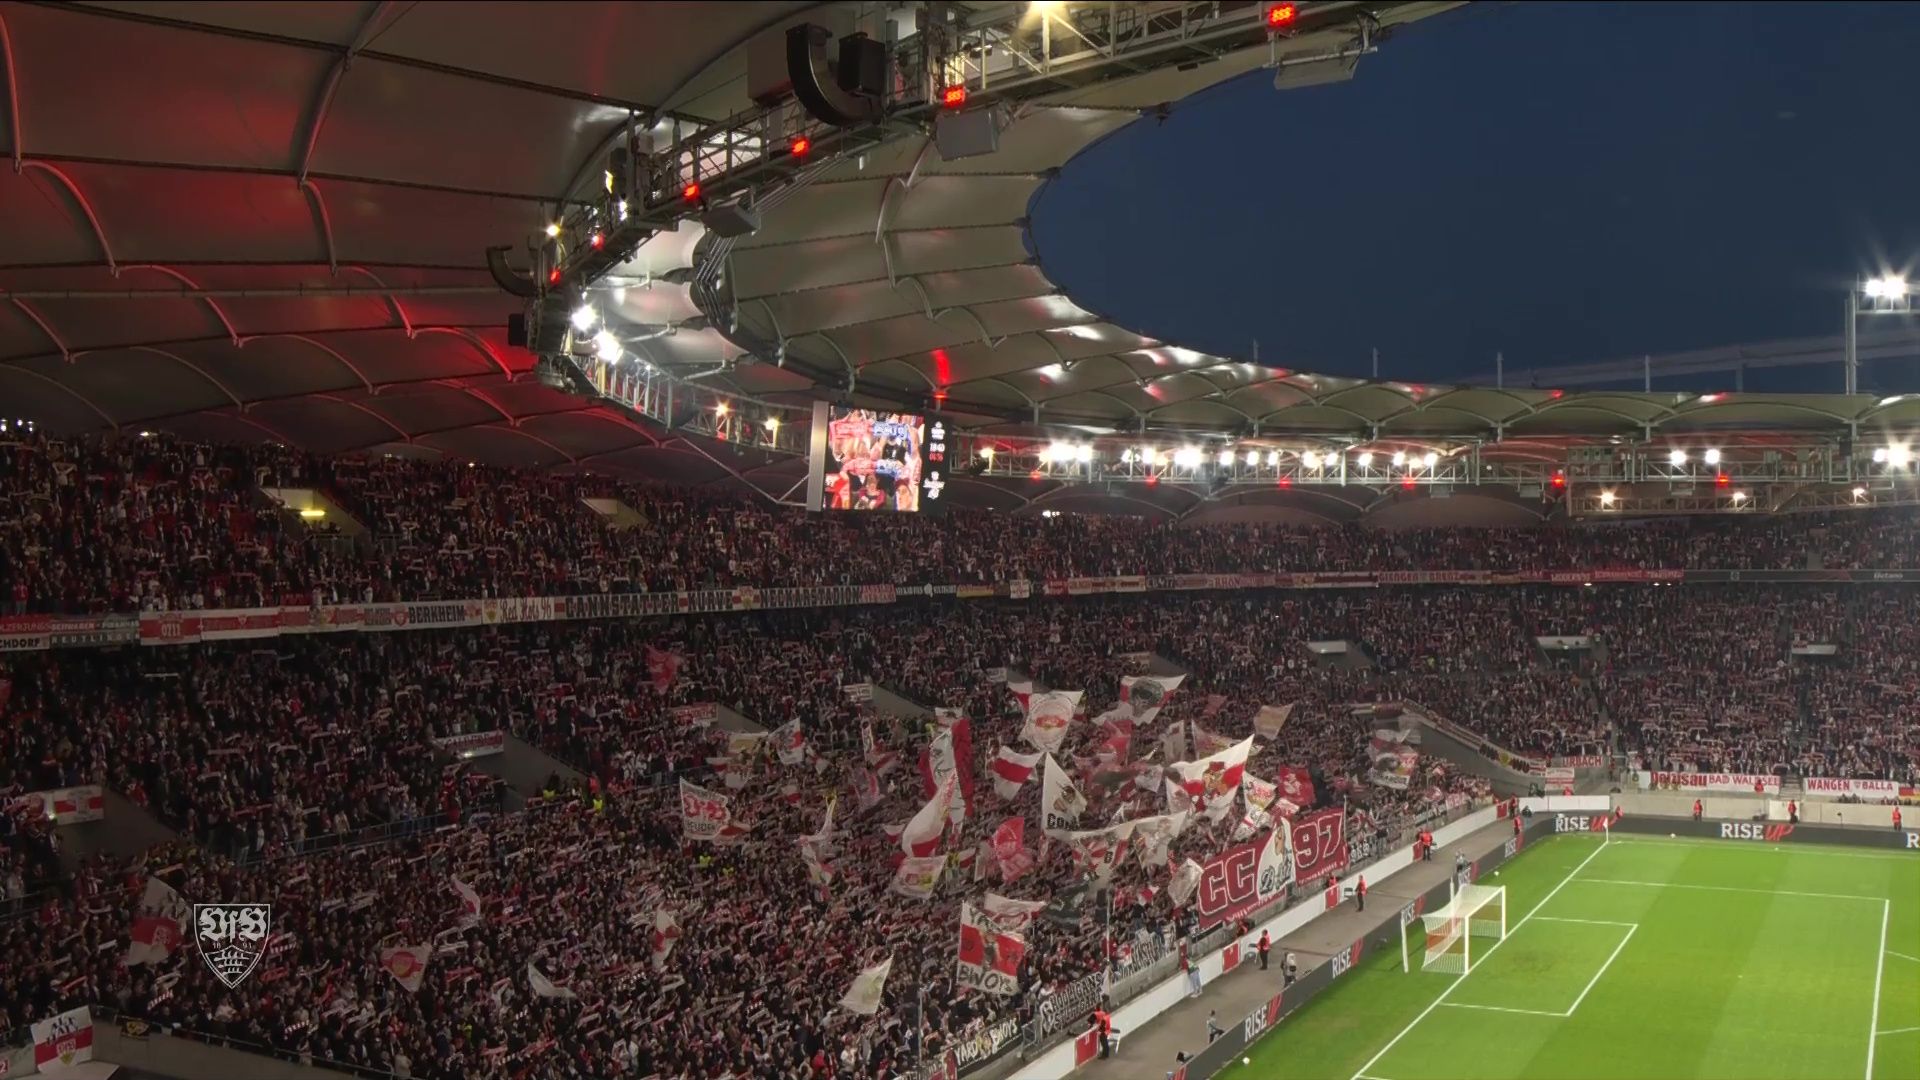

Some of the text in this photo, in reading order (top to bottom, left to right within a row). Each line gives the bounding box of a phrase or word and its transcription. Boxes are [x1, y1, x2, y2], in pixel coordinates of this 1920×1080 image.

[408, 605, 465, 624] BERKHEIM
[565, 593, 680, 618] CANNSTATTER
[687, 589, 733, 611] KURVE
[1708, 775, 1730, 785] BAD
[1808, 779, 1850, 791] WANGEN
[1555, 816, 1590, 833] RISE
[1721, 823, 1795, 842] RISE UP
[1198, 847, 1256, 917] CC
[1292, 811, 1343, 869] 97
[1332, 949, 1352, 979] RISE
[1050, 971, 1103, 1011] HOOLIGANS
[1244, 1005, 1268, 1043] RISE
[954, 1039, 978, 1066] YARD
